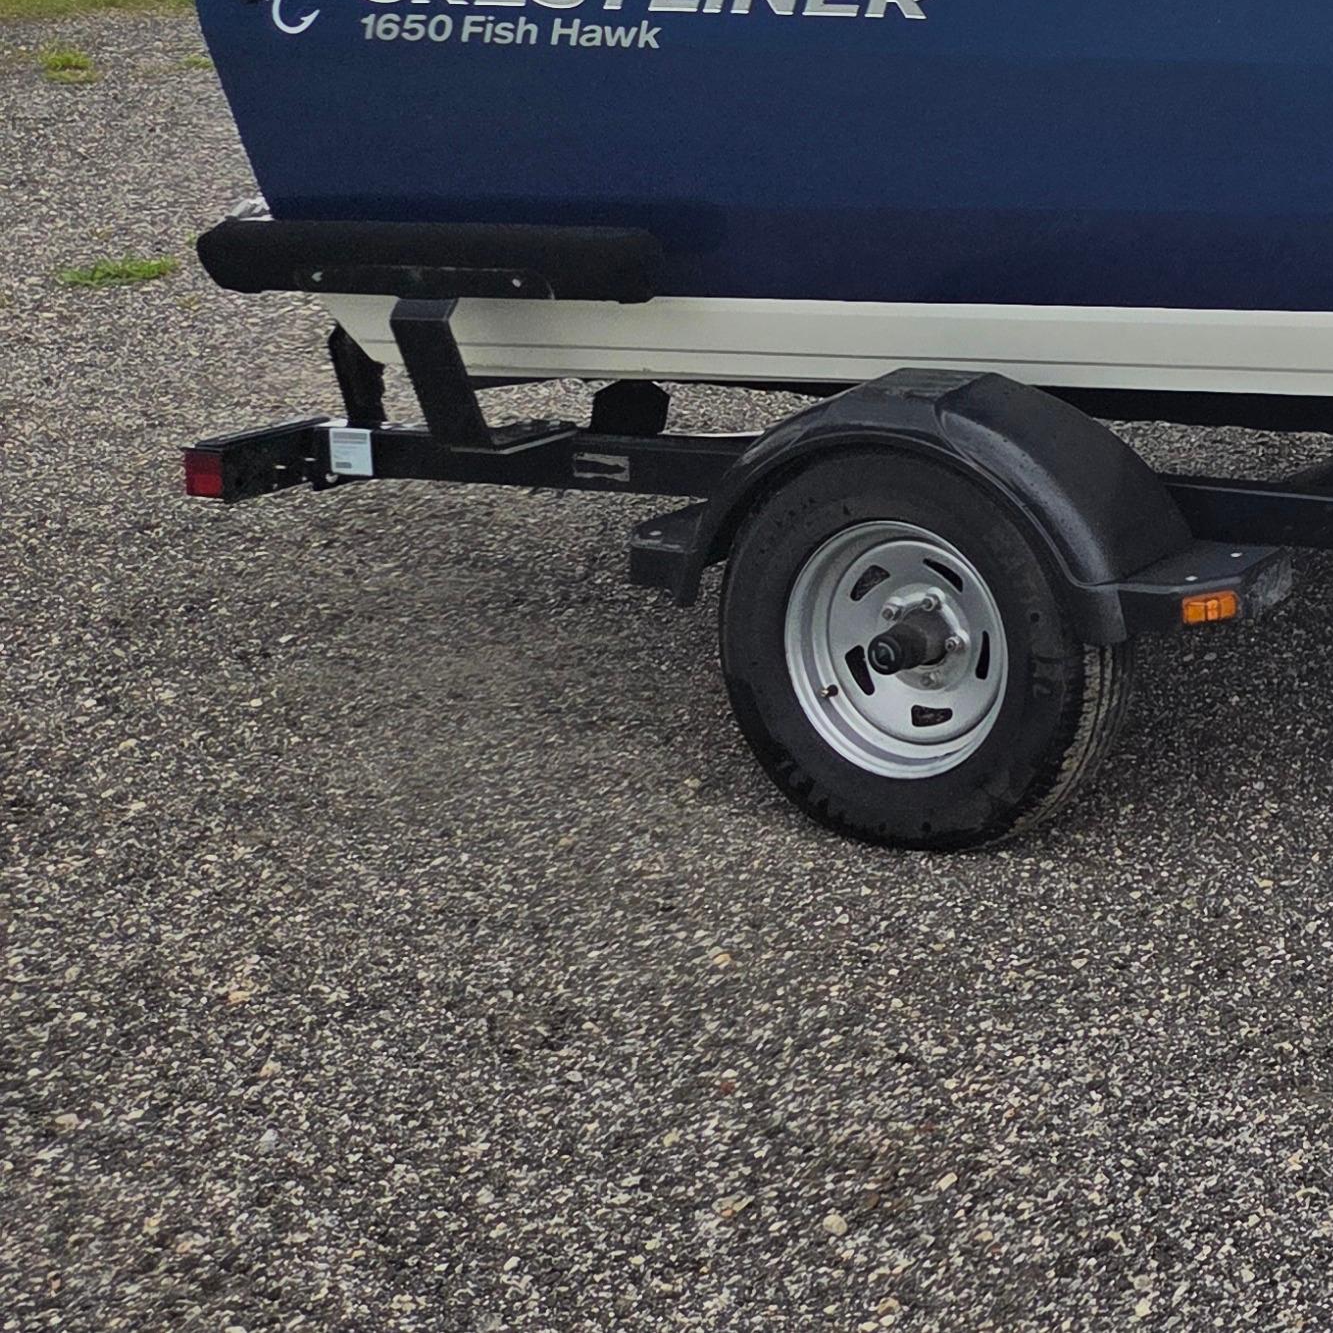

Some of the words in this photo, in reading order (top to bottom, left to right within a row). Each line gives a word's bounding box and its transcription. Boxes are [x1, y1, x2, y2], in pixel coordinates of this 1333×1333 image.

[361, 14, 453, 42] 1650
[461, 16, 537, 45] Fish
[551, 18, 660, 49] Hawk
